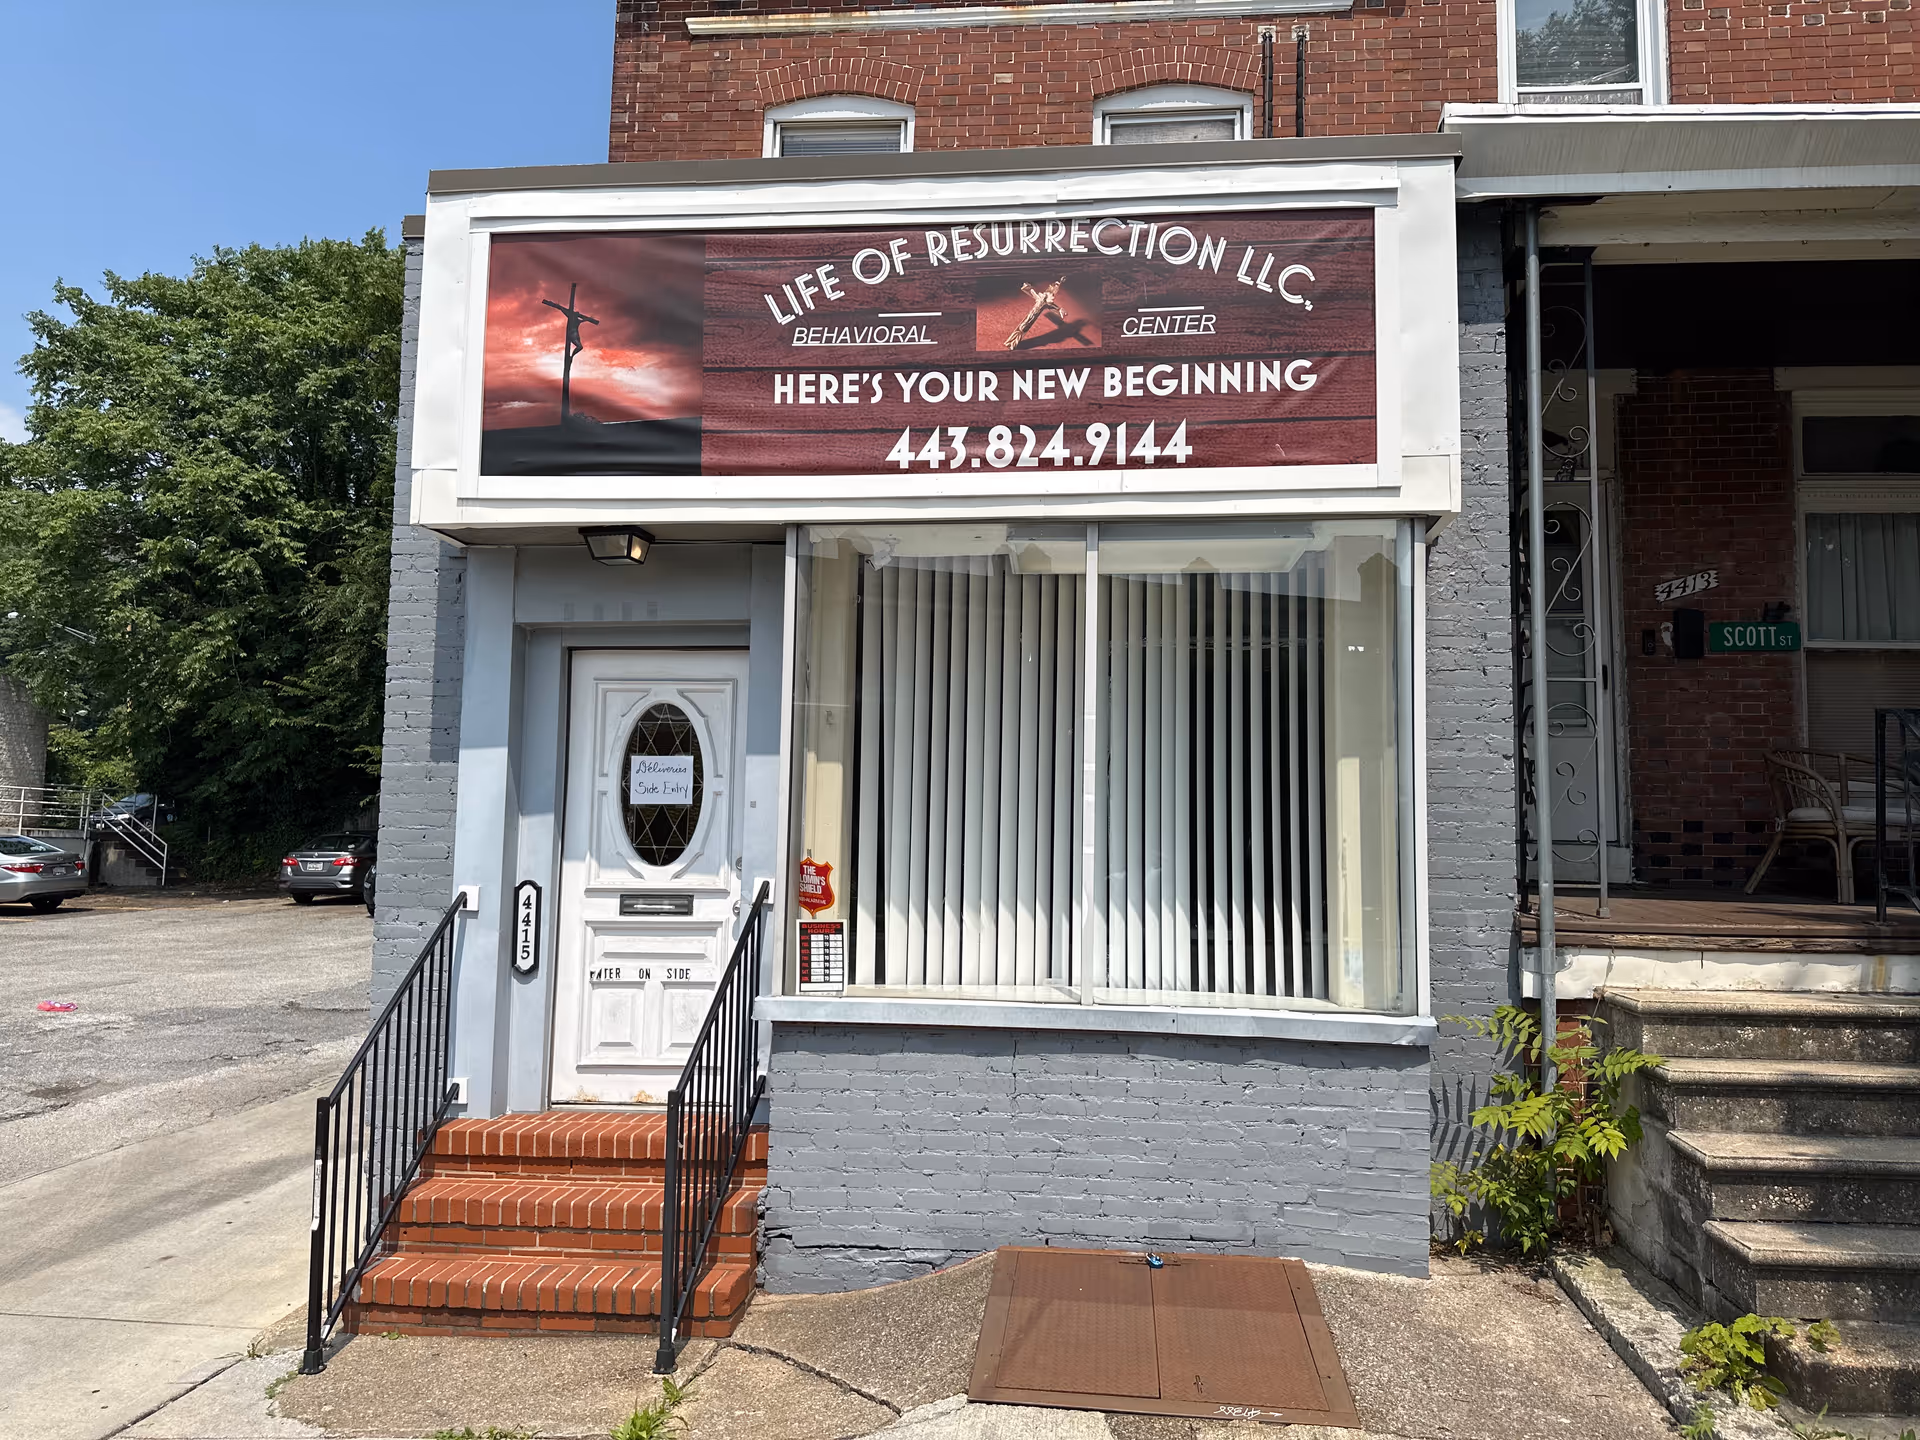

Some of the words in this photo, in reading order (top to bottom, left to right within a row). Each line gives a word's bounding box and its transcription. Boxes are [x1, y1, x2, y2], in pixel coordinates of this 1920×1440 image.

[764, 262, 845, 326] LIFE
[852, 237, 911, 285] OF
[925, 217, 1228, 275] RESURRECTION
[792, 324, 933, 345] BEHAVIORAL
[1122, 313, 1217, 336] CENTER
[774, 372, 884, 404] HERE'S
[894, 370, 1000, 404] YOUR
[1012, 366, 1092, 401] NEW
[1104, 358, 1318, 397] BEGINNING
[885, 417, 1193, 470] 443.824.9144
[1659, 571, 1713, 599] 4413
[1723, 626, 1777, 647] SCOTT
[1779, 635, 1793, 646] ST
[635, 760, 687, 774] Deliveries
[635, 781, 660, 795] Side
[663, 781, 689, 799] Entry
[799, 874, 826, 886] LOMIN'S
[802, 865, 817, 876] THE
[799, 883, 823, 894] SHIELD
[520, 894, 532, 960] 4415
[638, 967, 651, 980] ON
[666, 967, 691, 980] SIDE
